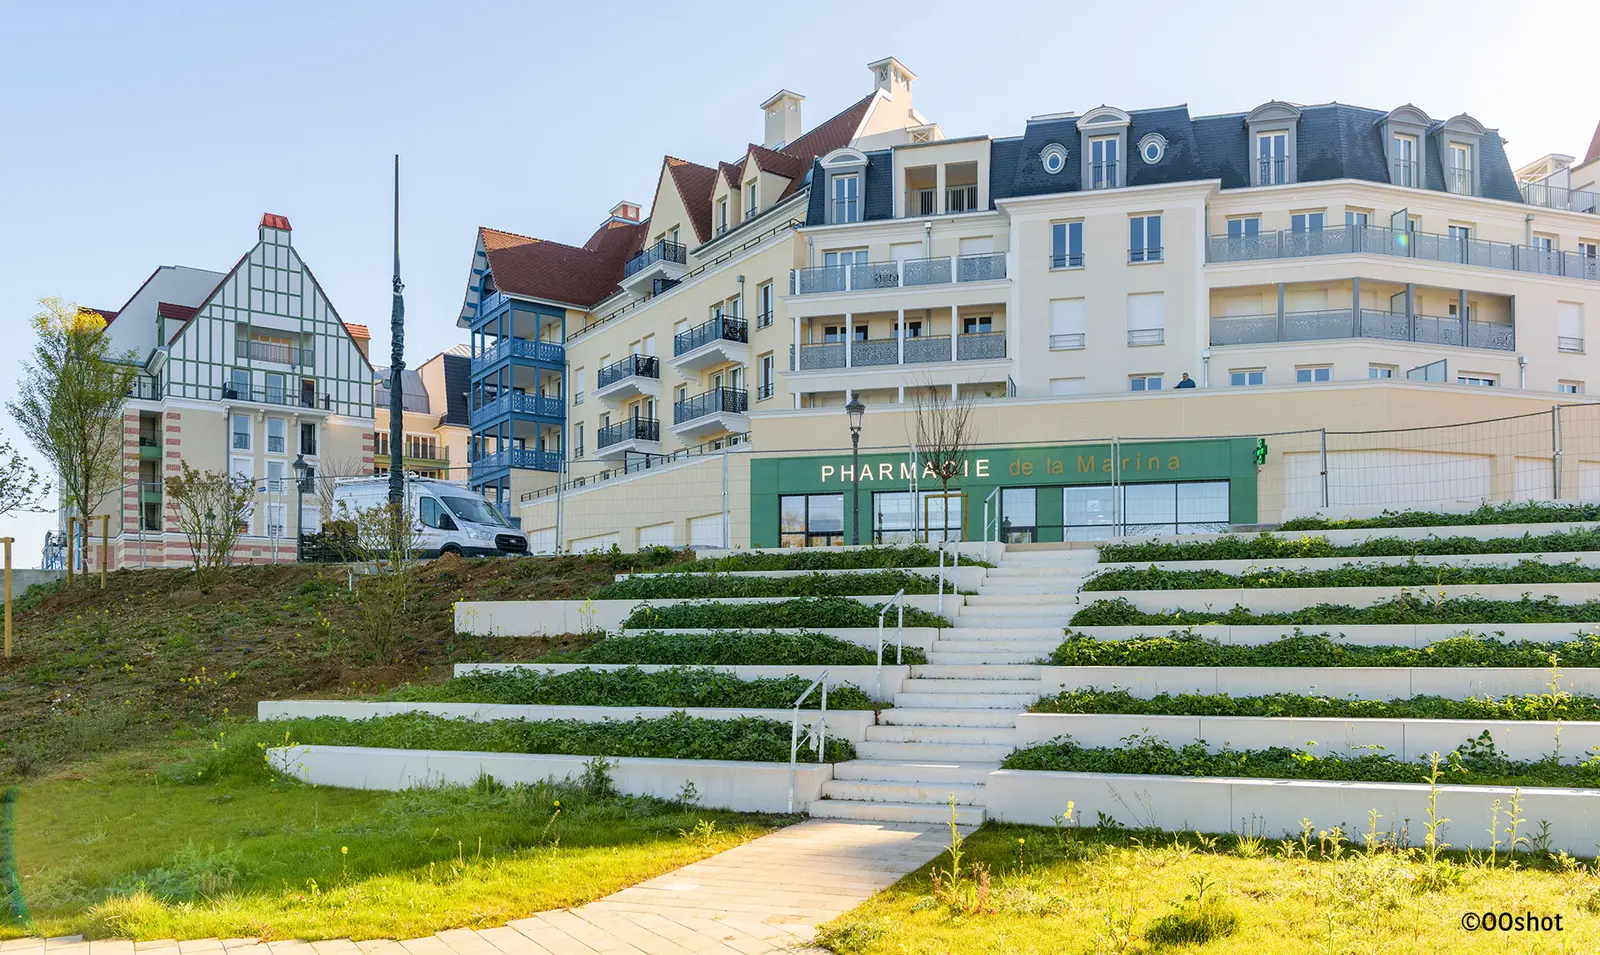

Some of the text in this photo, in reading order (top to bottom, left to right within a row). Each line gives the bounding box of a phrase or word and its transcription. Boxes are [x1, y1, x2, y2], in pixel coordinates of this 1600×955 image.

[1008, 458, 1033, 476] de
[1046, 457, 1064, 474] la
[1077, 453, 1180, 473] Marina
